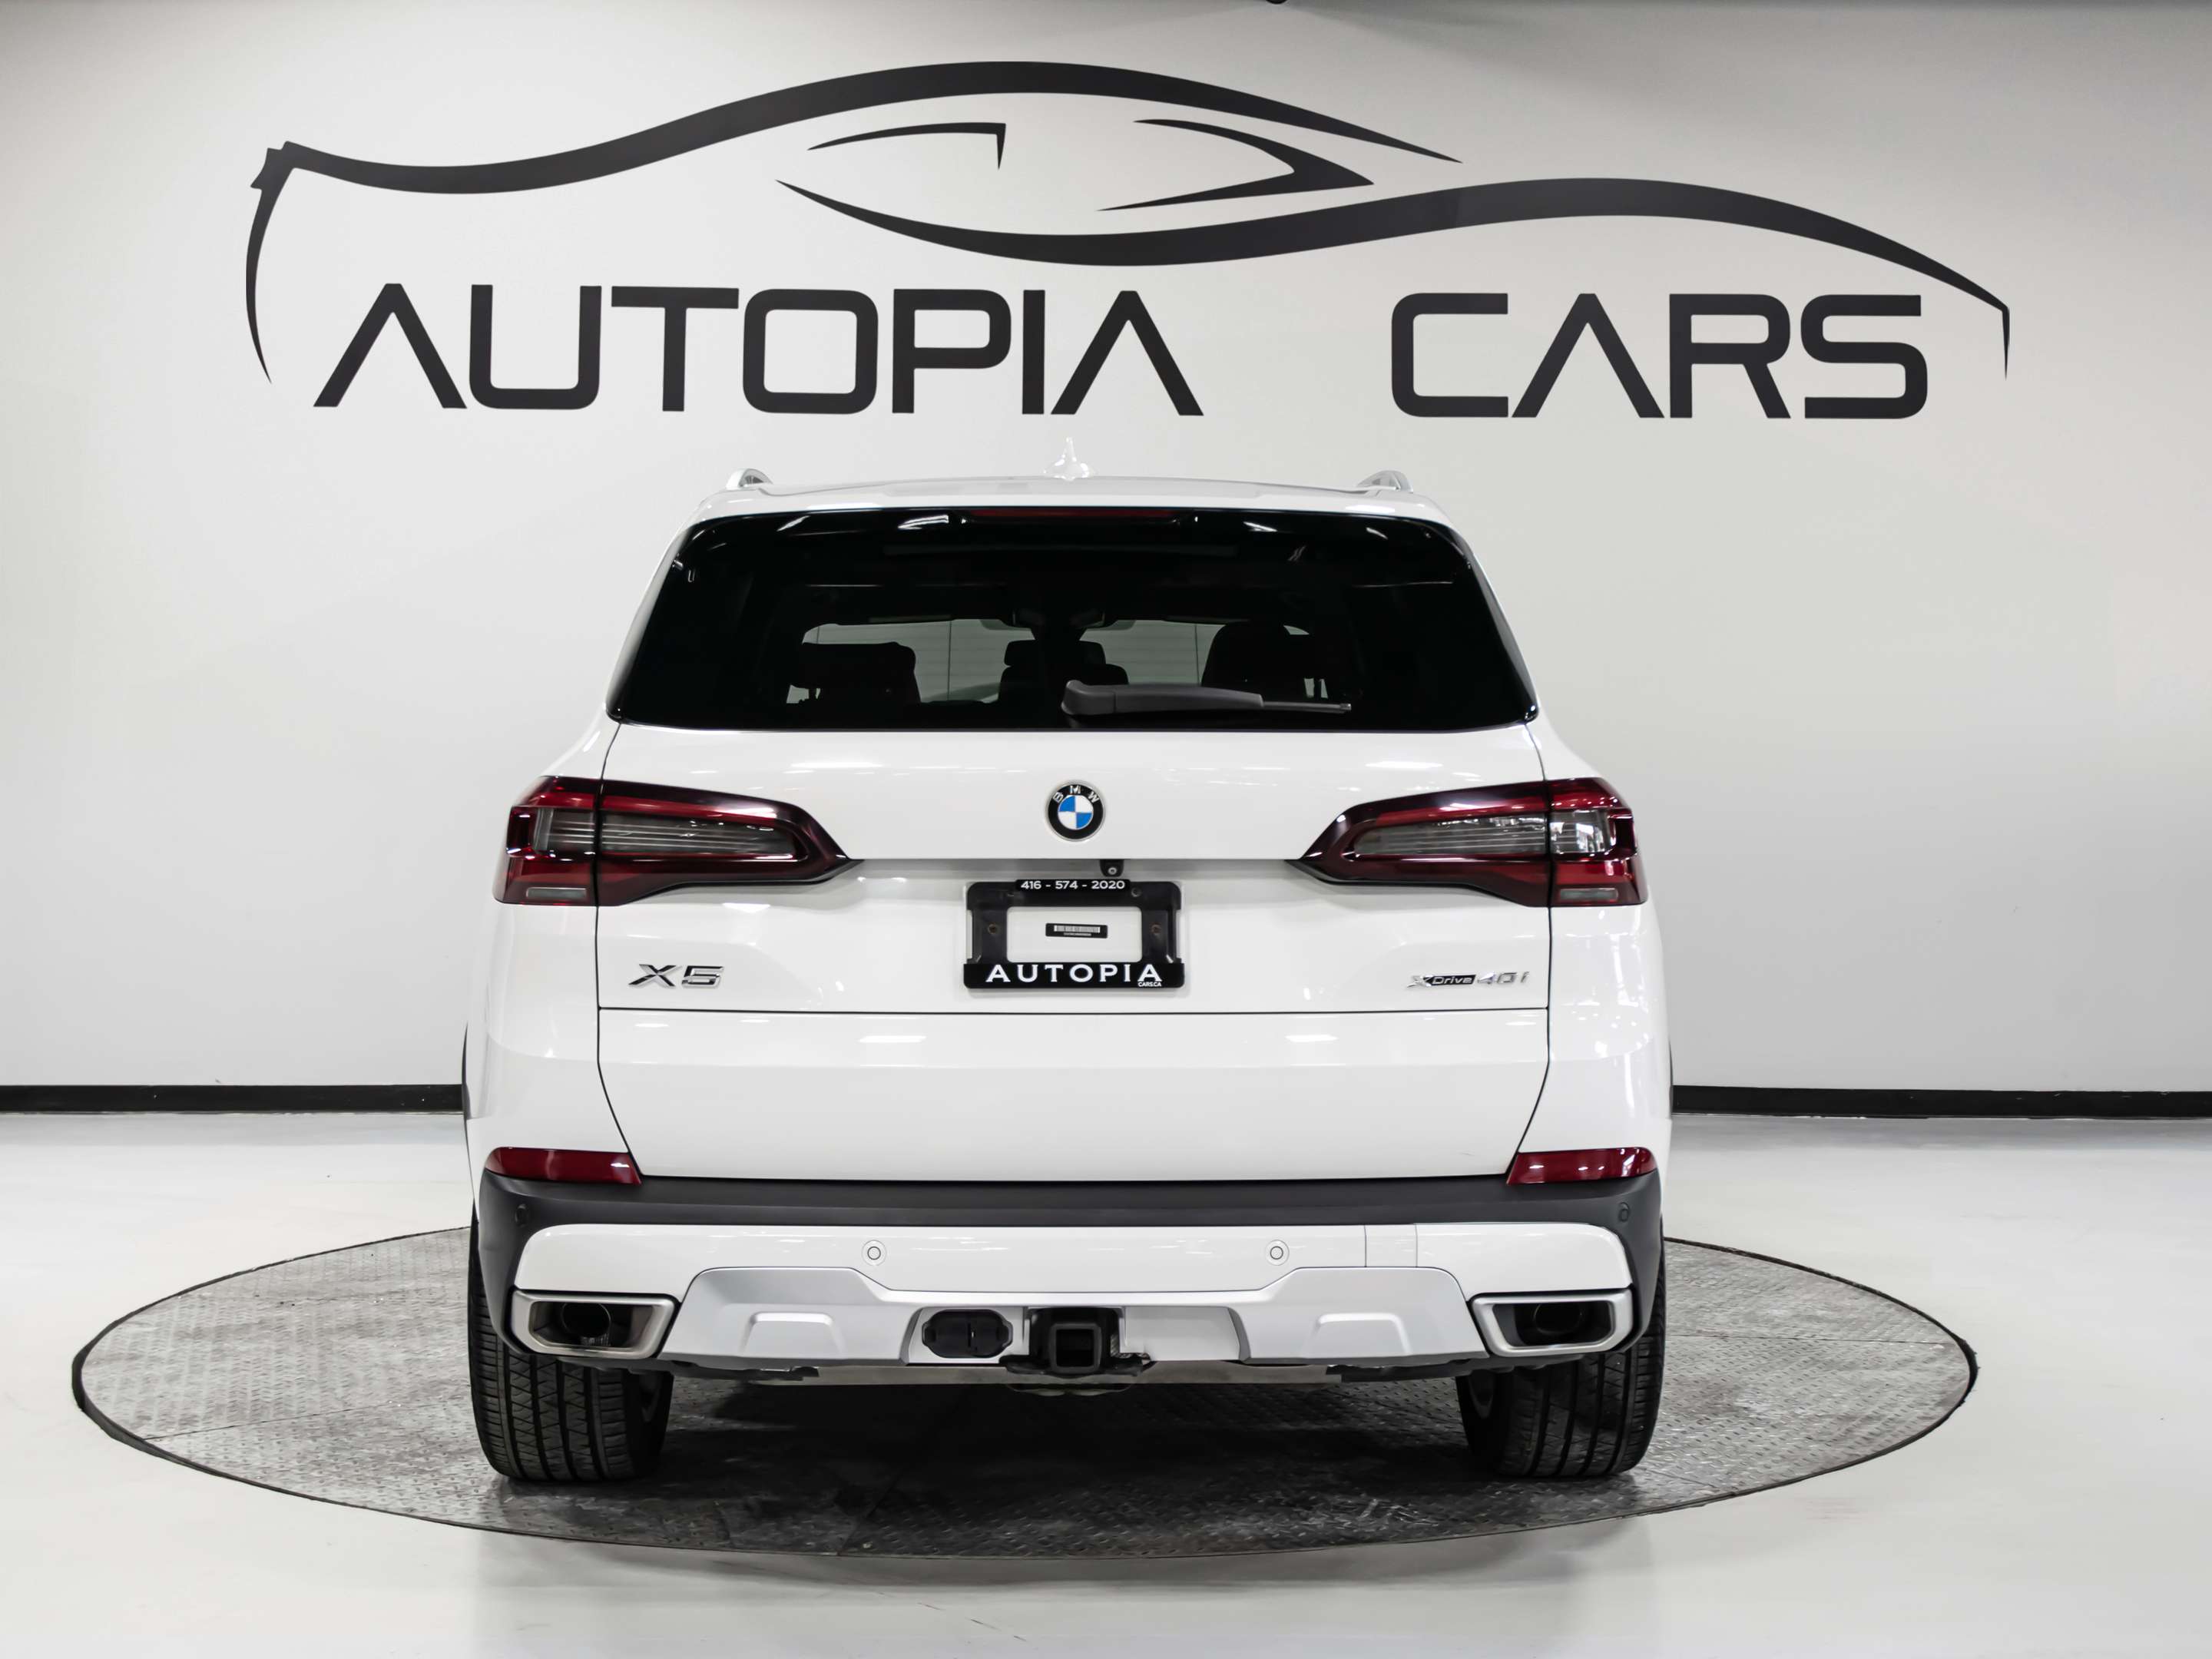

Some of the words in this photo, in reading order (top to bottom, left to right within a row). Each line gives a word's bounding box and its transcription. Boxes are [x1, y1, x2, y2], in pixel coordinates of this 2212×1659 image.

[313, 283, 1204, 416] AUTOPIA
[1391, 293, 1928, 419] CARS
[1052, 785, 1100, 803] BMW
[1020, 880, 1042, 889] 416
[1055, 880, 1078, 889] 574
[1091, 880, 1125, 889] 2020
[628, 963, 724, 989] X5
[985, 963, 1163, 982] AUTOPIA
